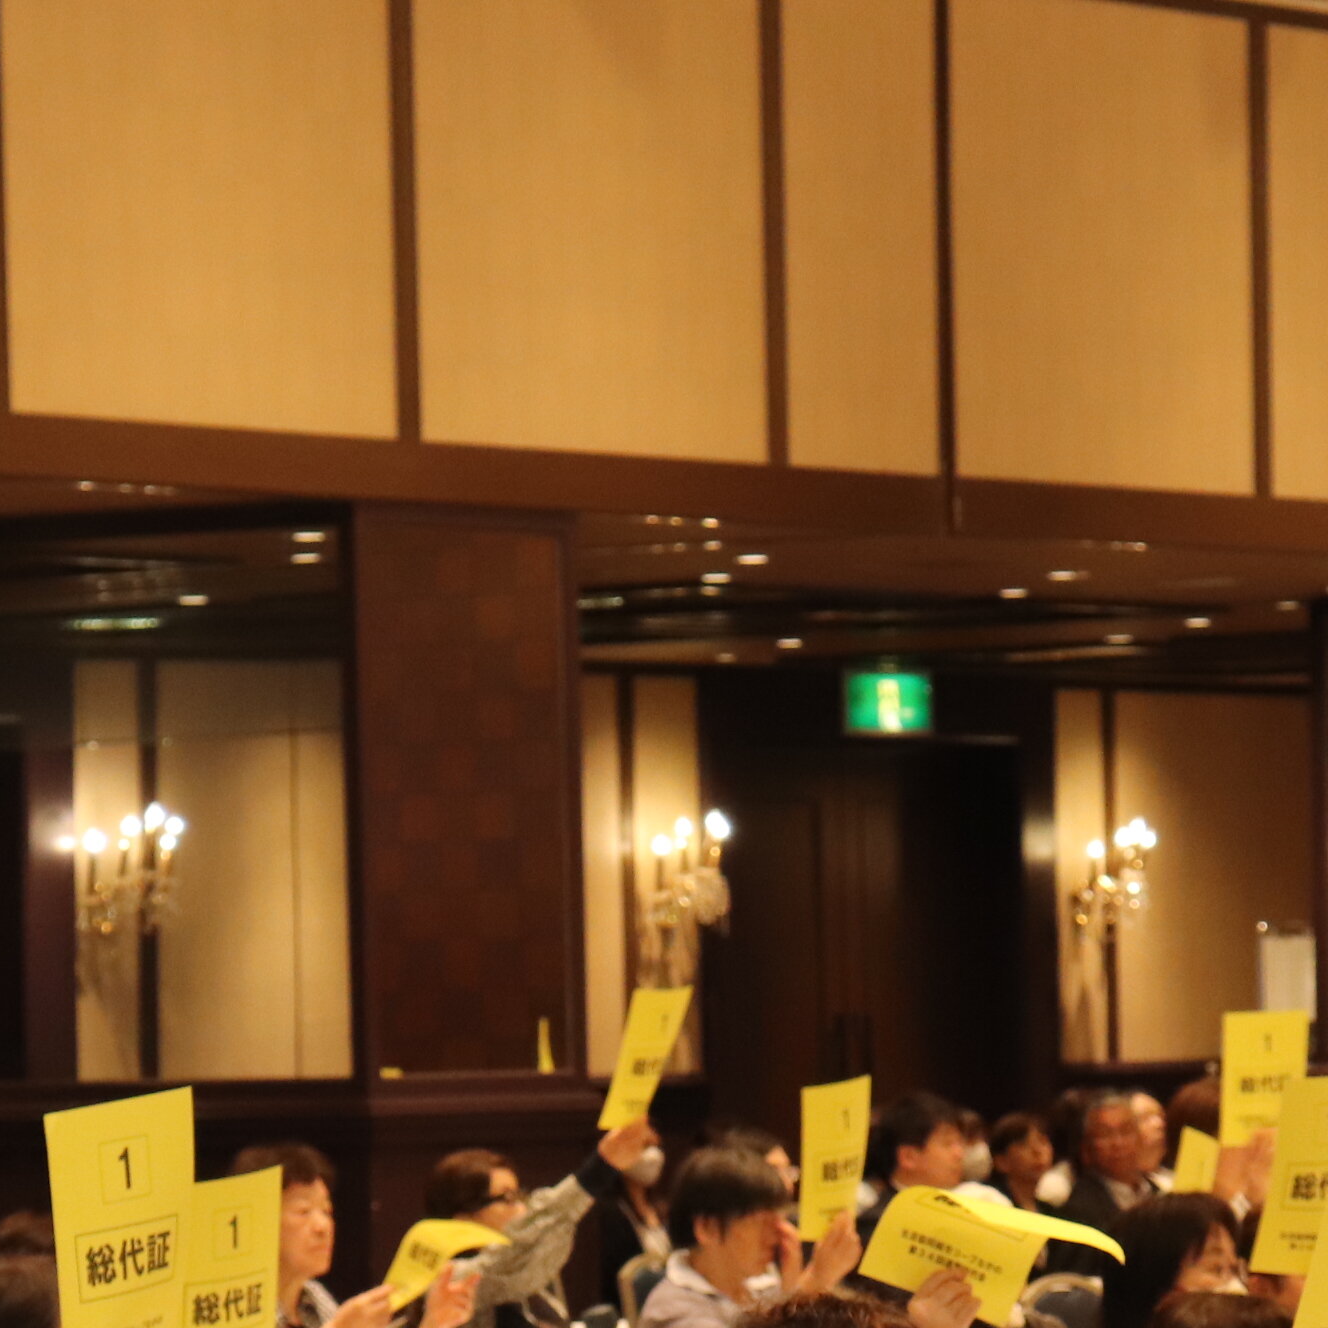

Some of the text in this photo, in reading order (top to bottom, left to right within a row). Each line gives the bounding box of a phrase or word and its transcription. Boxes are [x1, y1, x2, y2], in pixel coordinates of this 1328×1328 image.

[118, 1146, 132, 1190] 1
[229, 1214, 239, 1250] 1
[85, 1230, 171, 1287] 総代証
[191, 1283, 263, 1327] 総代証
